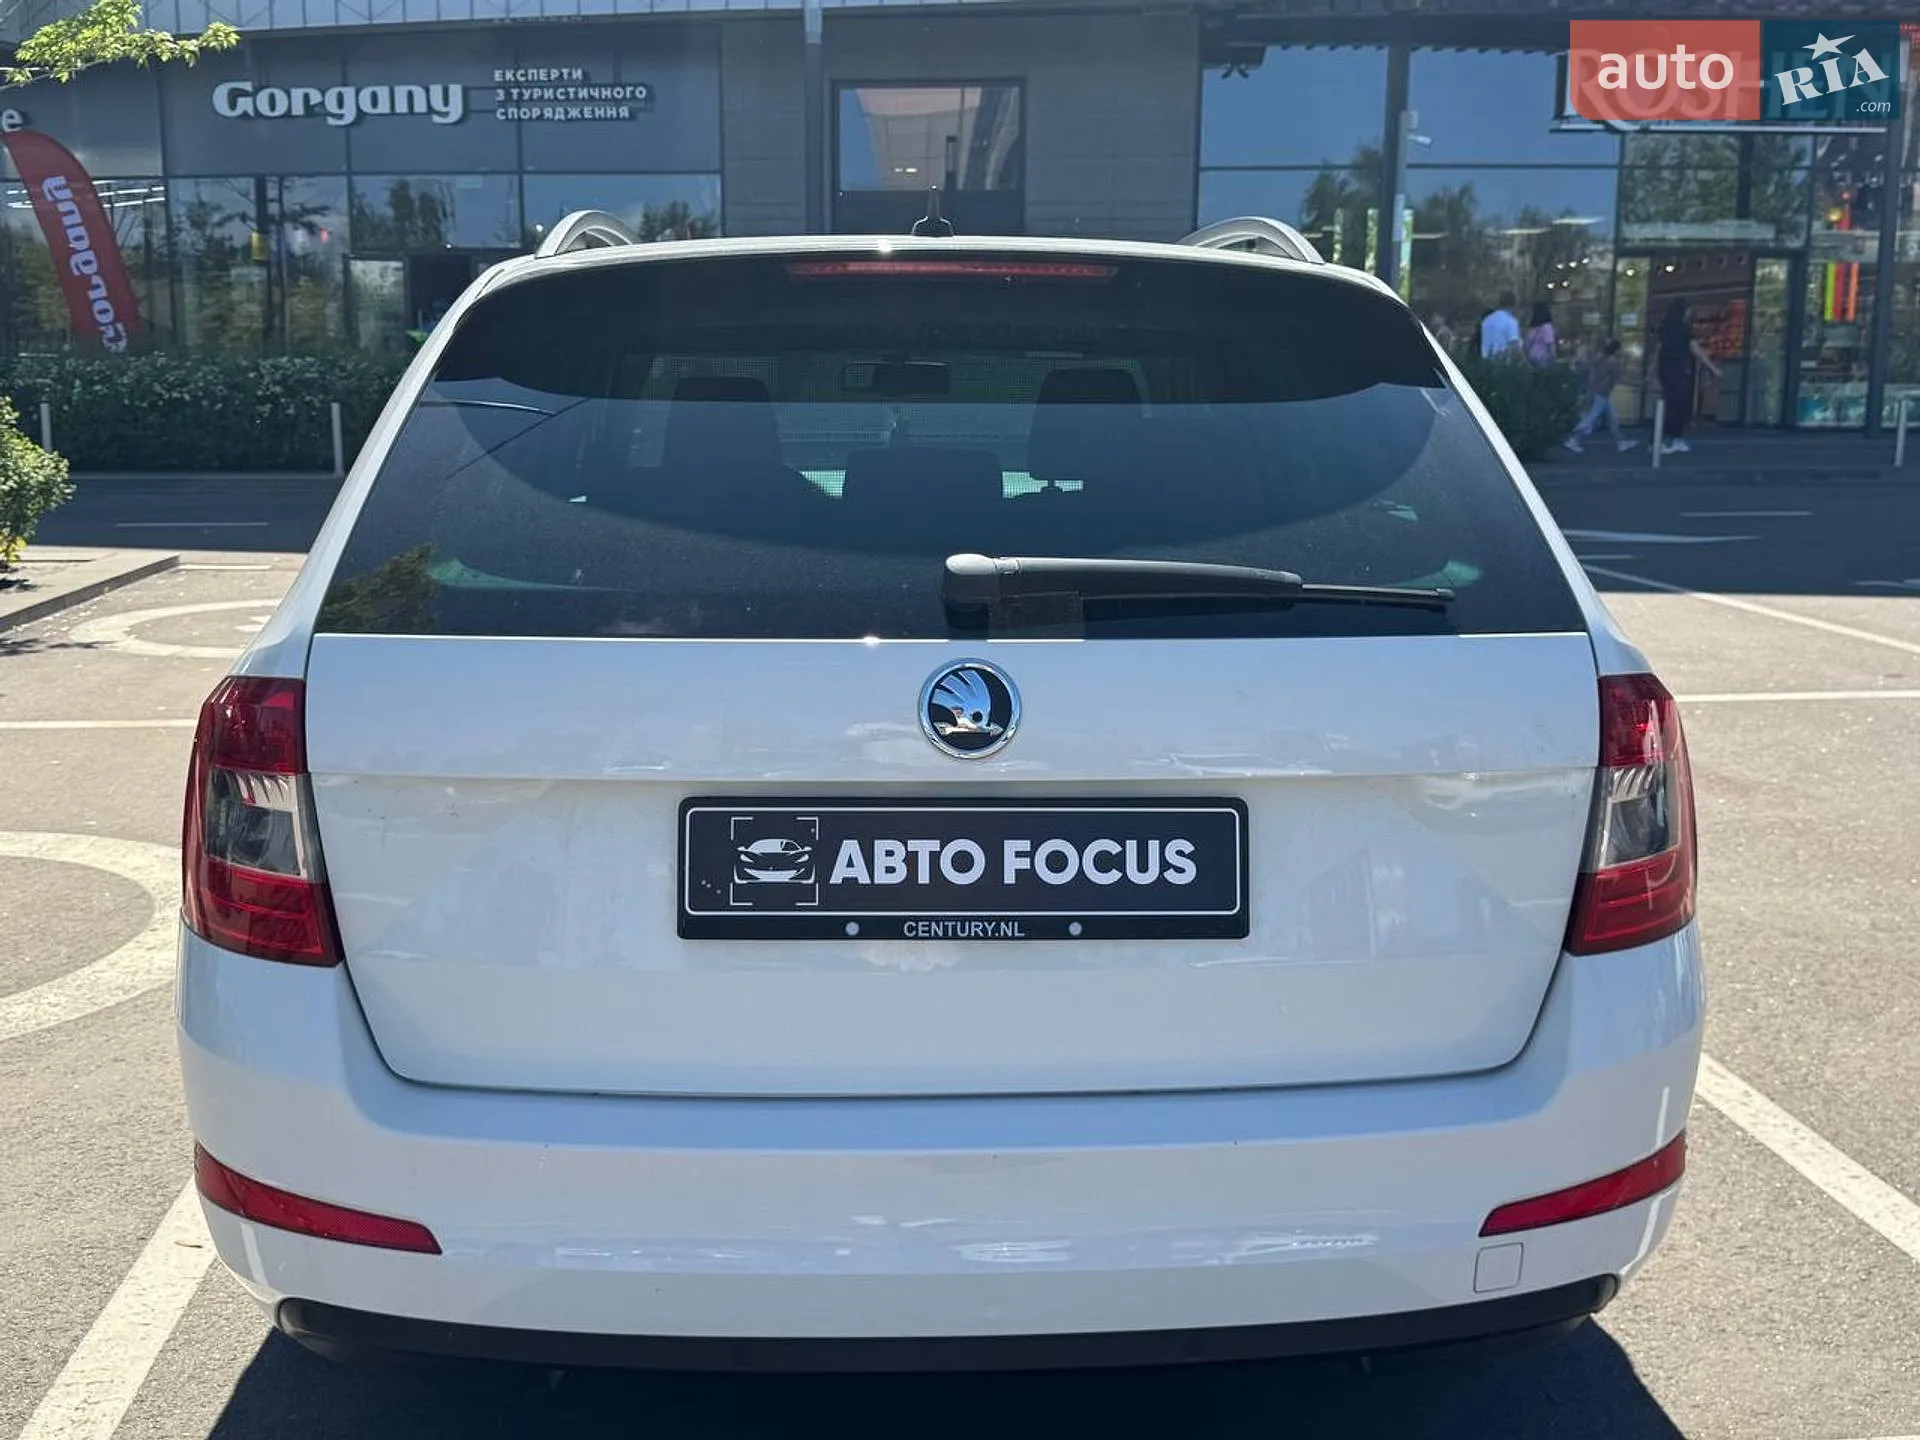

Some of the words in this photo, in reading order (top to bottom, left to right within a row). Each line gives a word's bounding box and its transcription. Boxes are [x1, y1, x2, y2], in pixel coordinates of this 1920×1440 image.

[494, 68, 583, 81] ЕКСПЕРТИ
[510, 86, 647, 100] ТУРИСТИЧНОГО
[212, 81, 463, 126] Gorgany
[496, 106, 630, 121] СПОРЯДЖЕННЯ
[829, 839, 986, 885] АВТО
[1003, 839, 1197, 885] FOCUS
[903, 922, 1024, 938] CENTURY.NL
